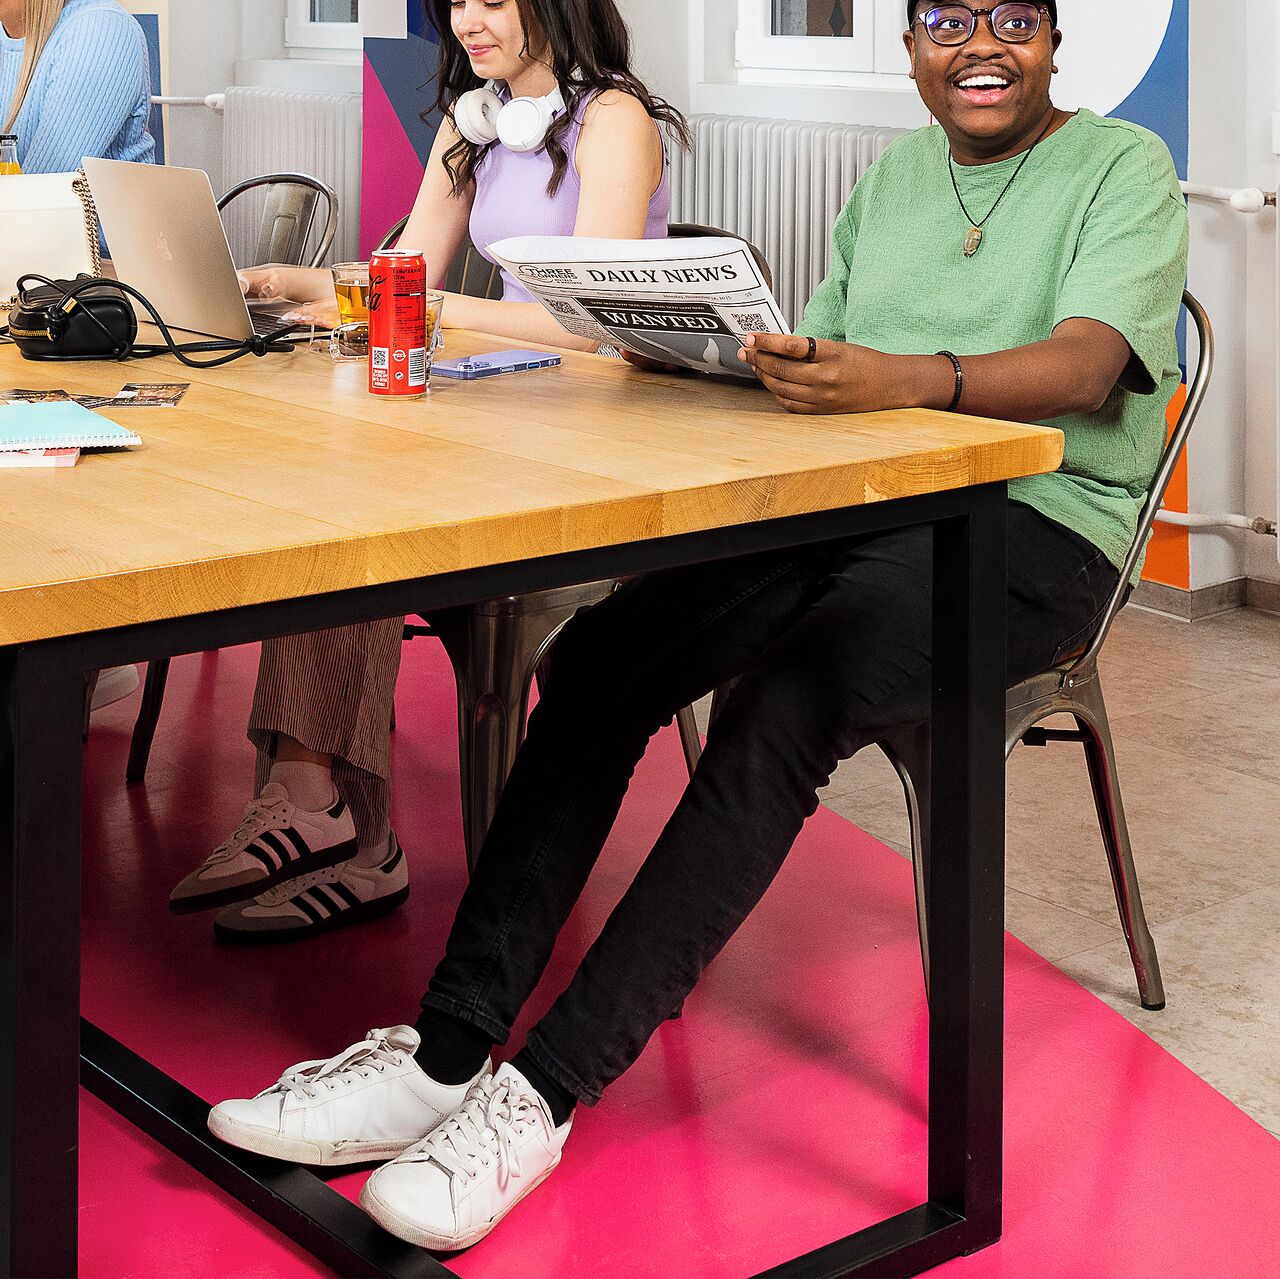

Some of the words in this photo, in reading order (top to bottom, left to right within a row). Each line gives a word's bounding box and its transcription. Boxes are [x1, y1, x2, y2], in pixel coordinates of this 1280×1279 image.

[586, 269, 660, 282] DAILY
[662, 264, 738, 283] NEWS
[600, 312, 719, 330] WANTED
